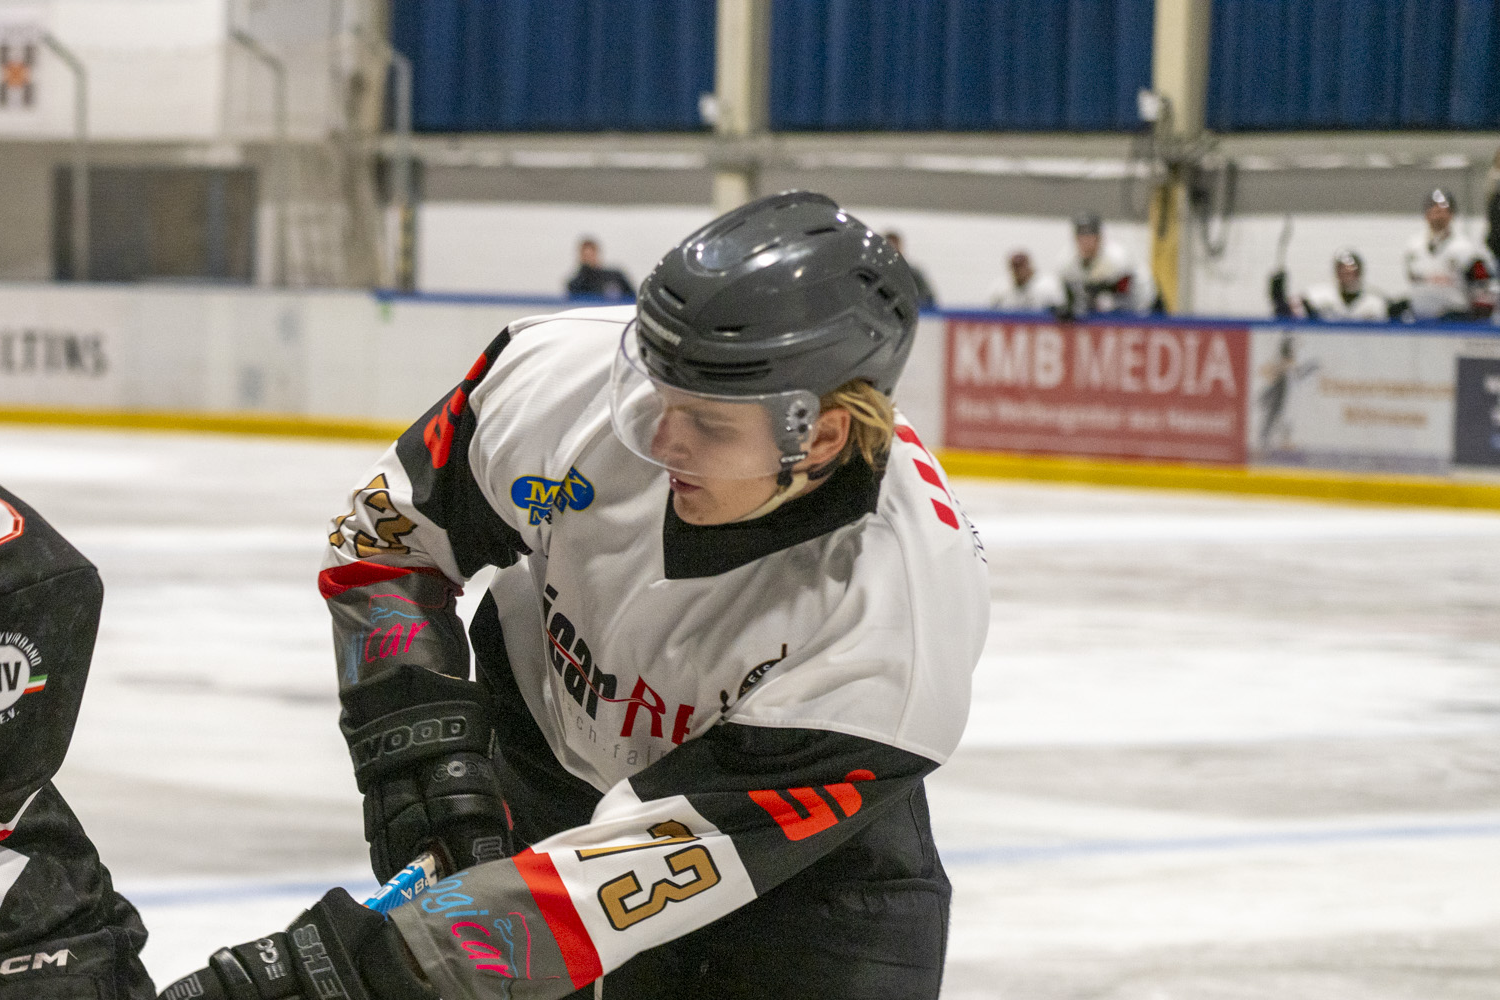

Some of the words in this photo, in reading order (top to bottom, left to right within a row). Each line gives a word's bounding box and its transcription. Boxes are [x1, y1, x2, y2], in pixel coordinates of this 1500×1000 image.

[952, 328, 1064, 387] KMB
[1074, 328, 1236, 395] MEDIA
[575, 819, 722, 932] 13
